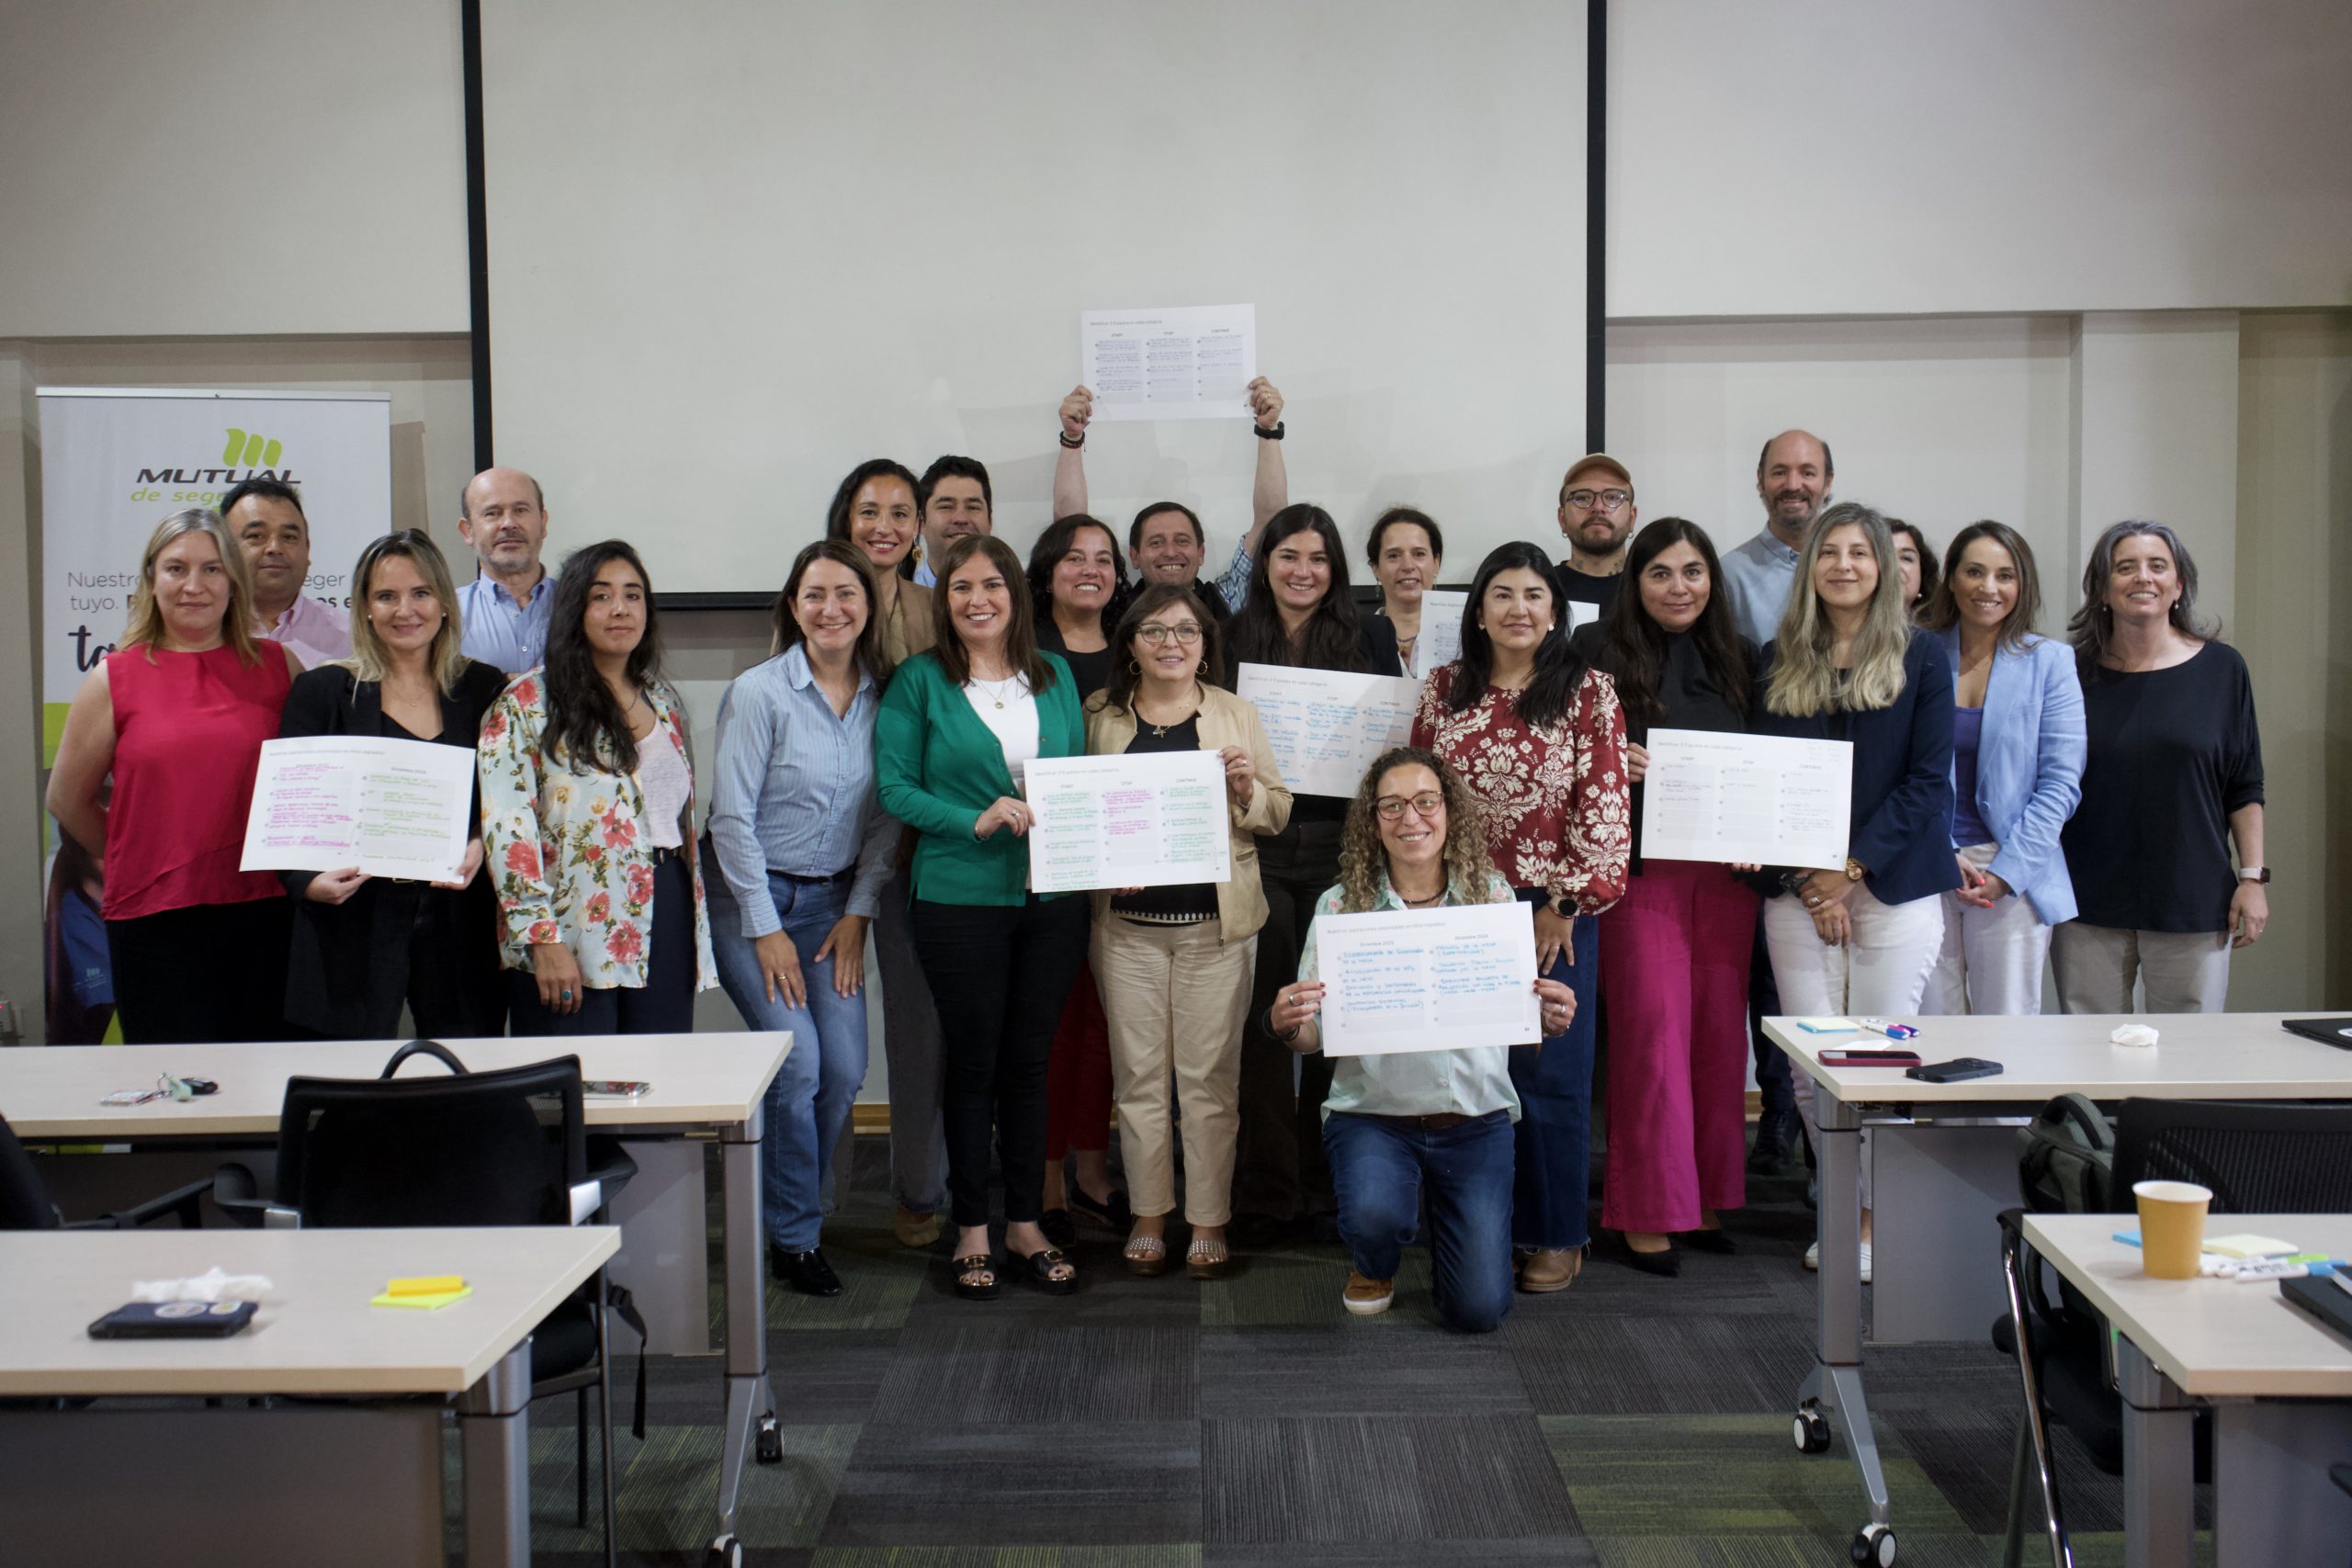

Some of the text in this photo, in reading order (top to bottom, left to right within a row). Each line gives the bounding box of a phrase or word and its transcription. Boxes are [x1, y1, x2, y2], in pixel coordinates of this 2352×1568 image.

[136, 469, 302, 484] MUTUAL
[130, 487, 162, 502] de
[70, 595, 119, 614] tuyo.
